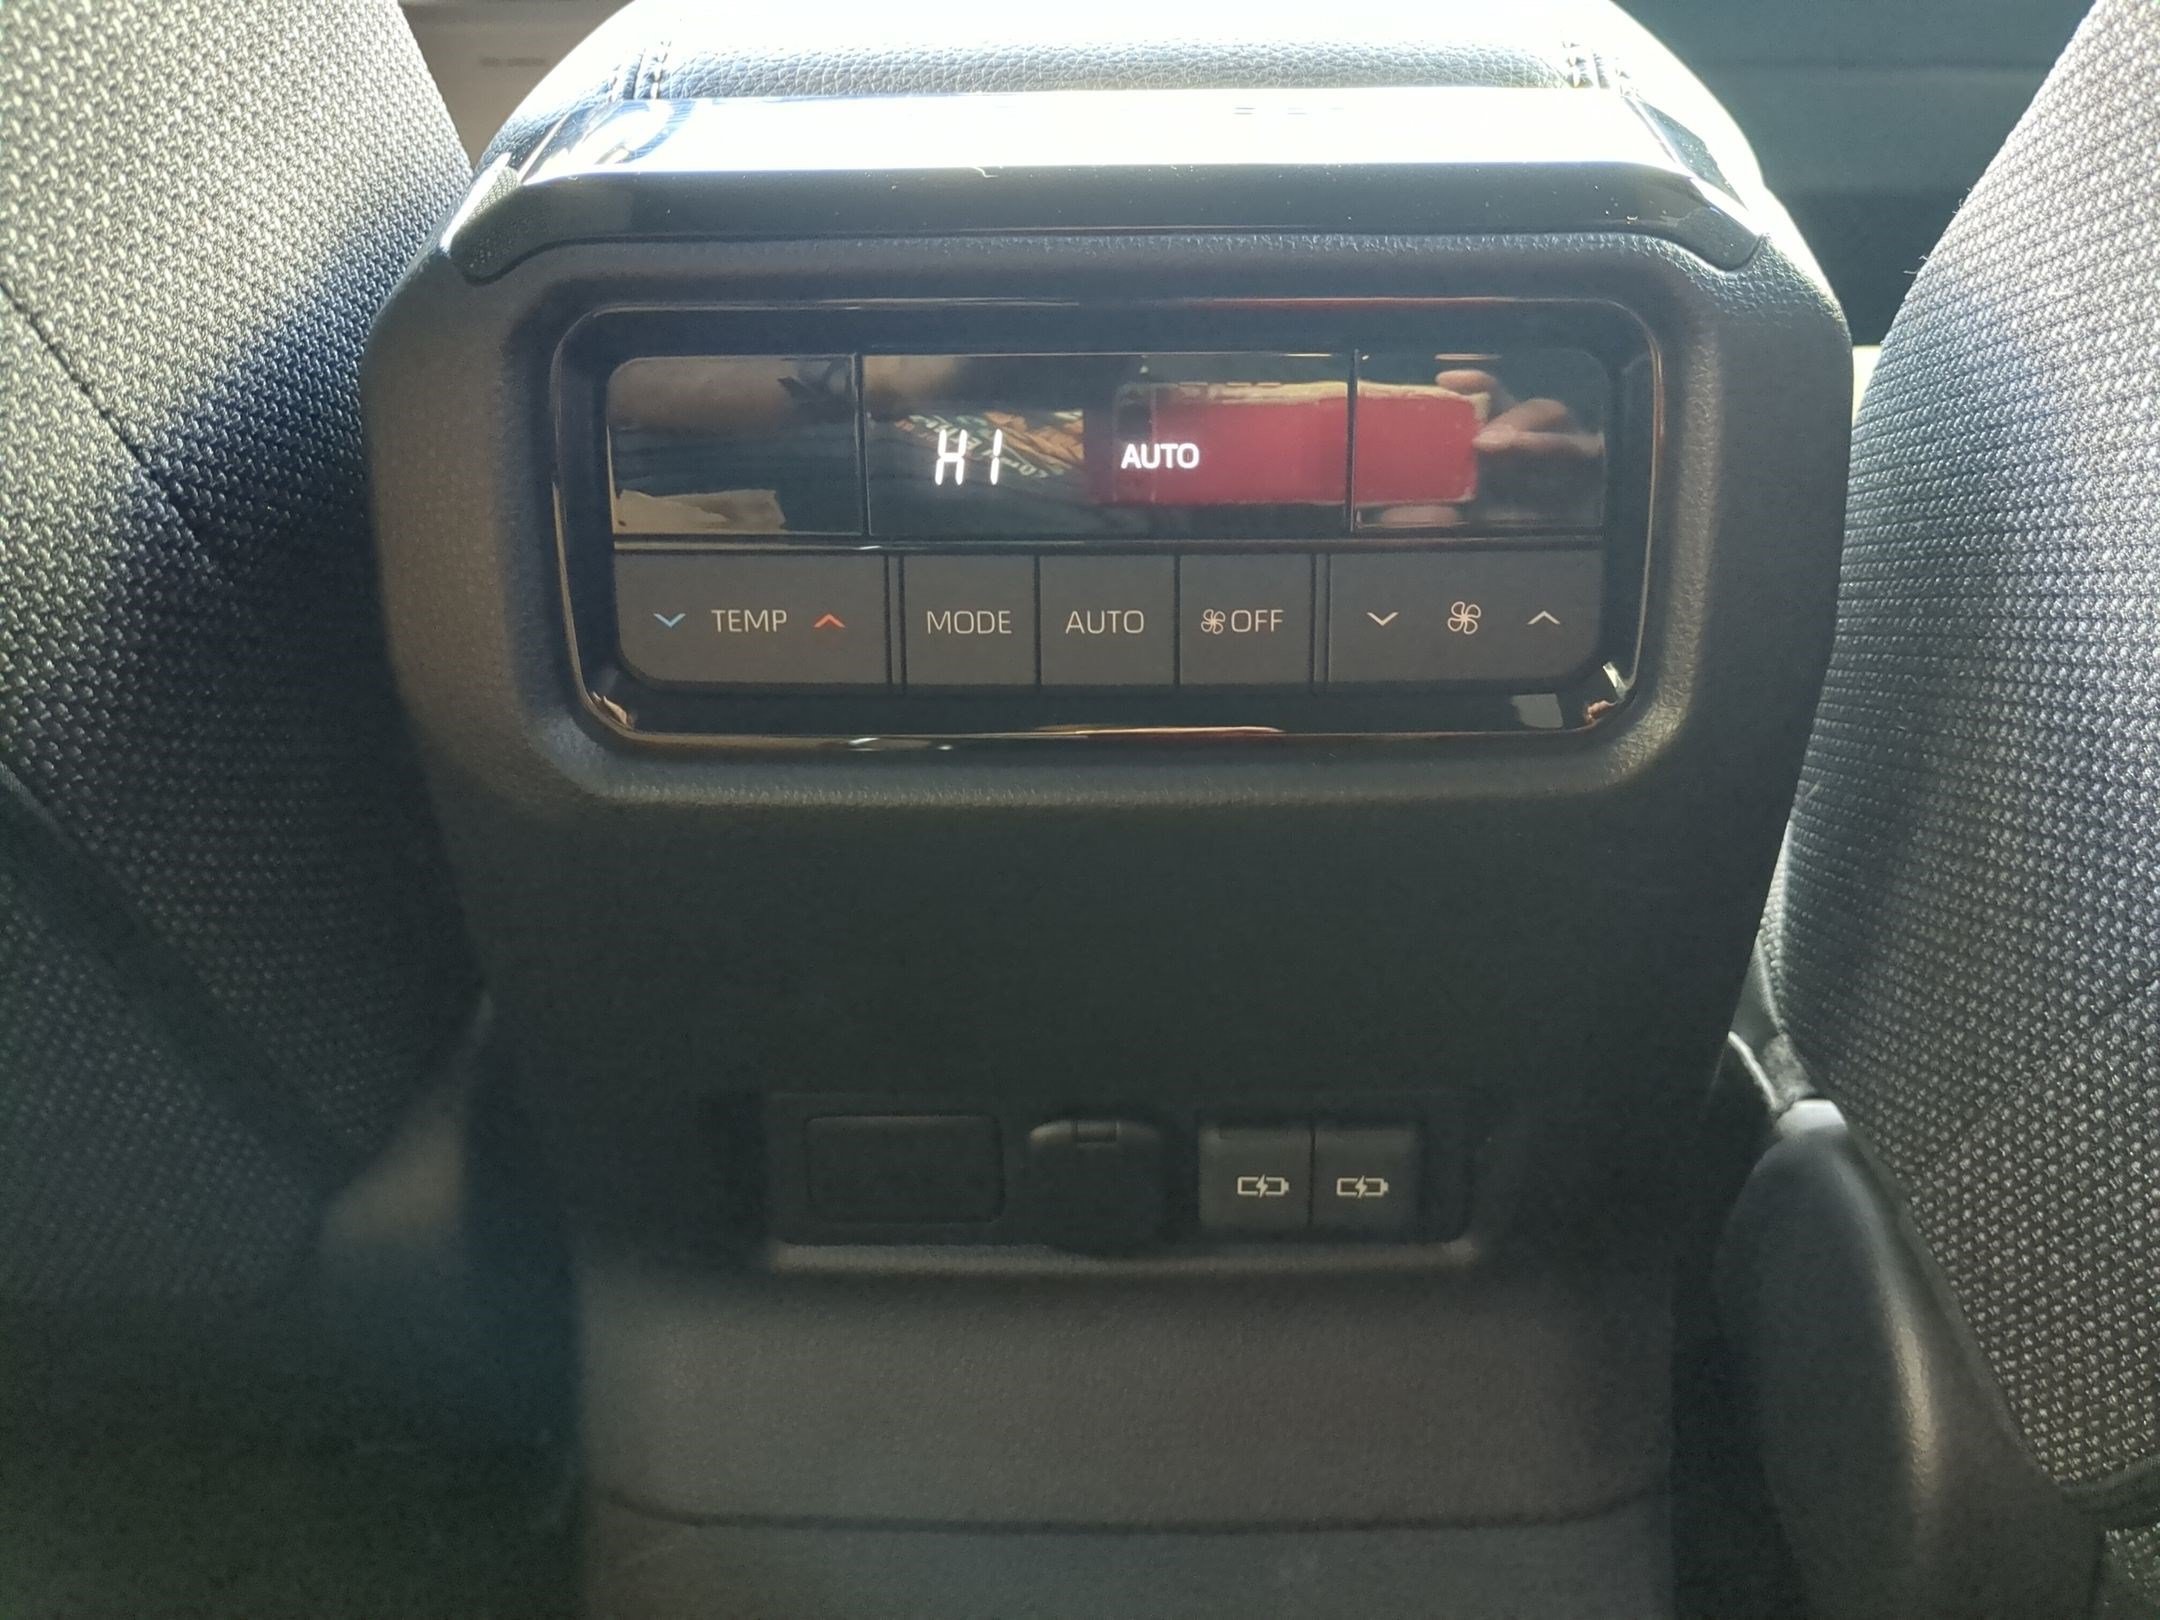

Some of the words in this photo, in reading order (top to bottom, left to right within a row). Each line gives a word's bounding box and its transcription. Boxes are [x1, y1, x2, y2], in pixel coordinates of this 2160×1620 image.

[935, 429, 1003, 486] HI
[1120, 442, 1200, 469] AUTO
[711, 609, 788, 633] TEMP
[926, 610, 1012, 635] MODE
[1065, 609, 1145, 635] AUTO
[1230, 608, 1284, 633] OFF
